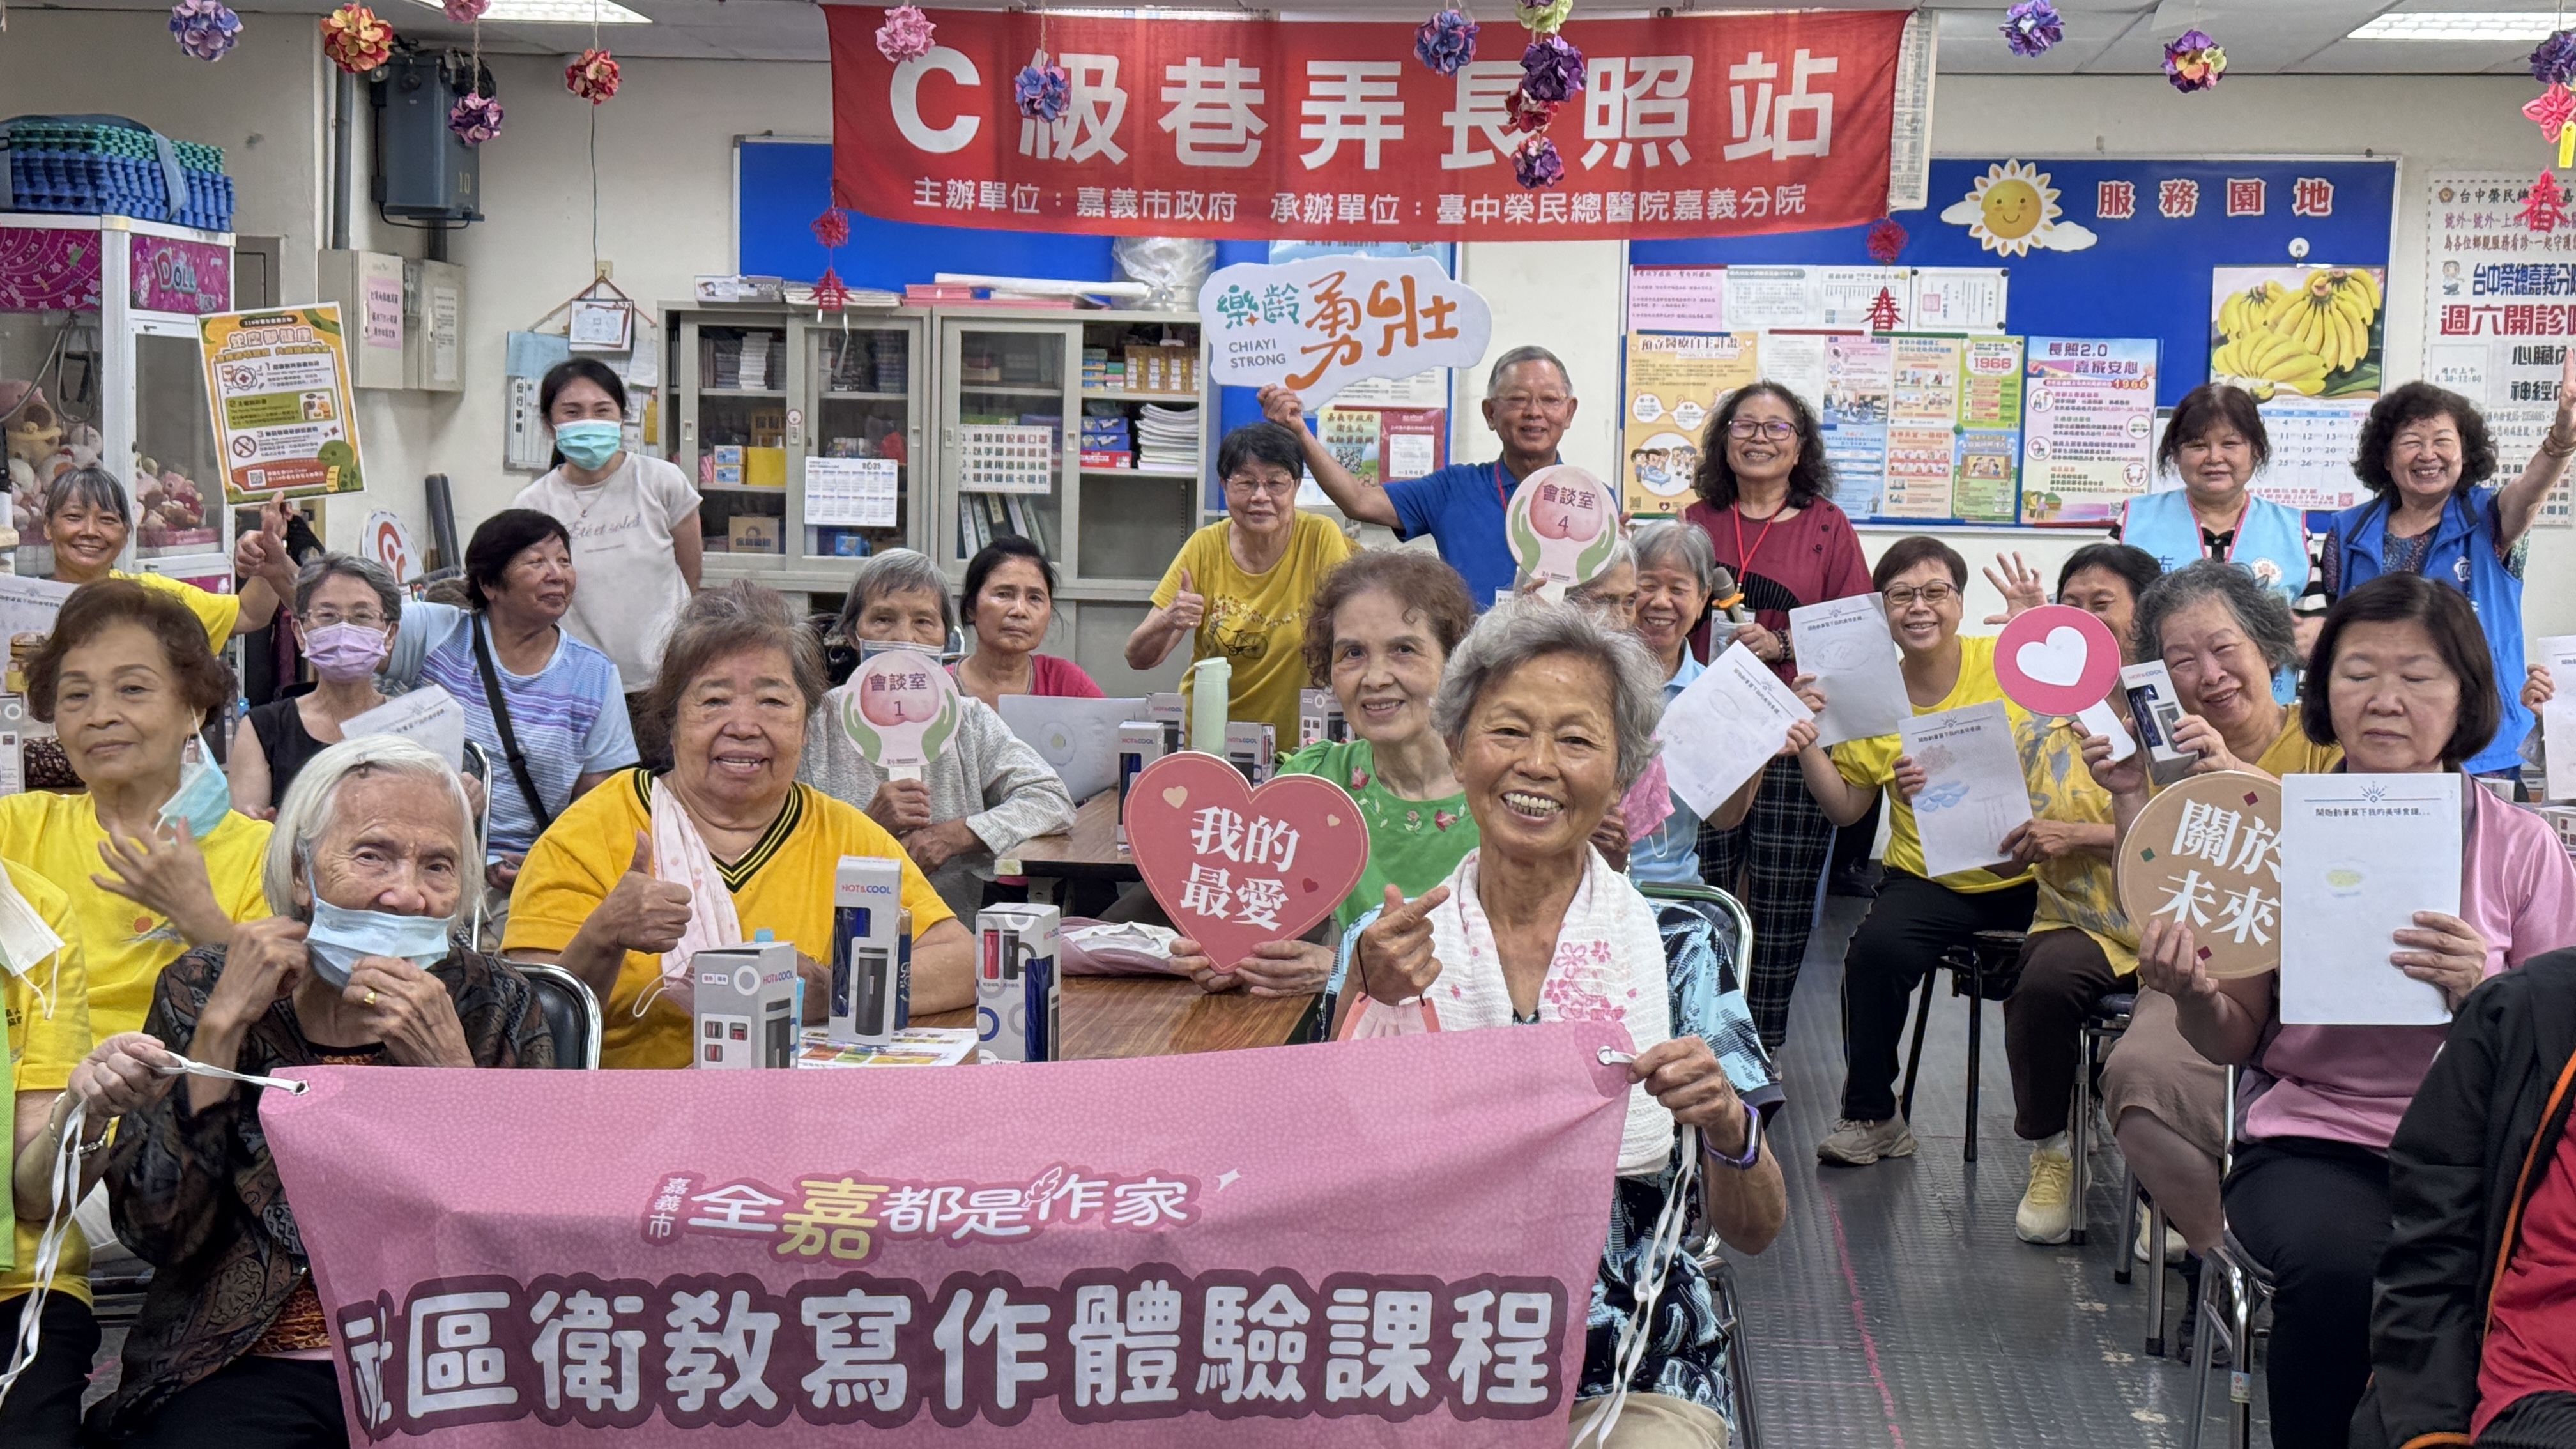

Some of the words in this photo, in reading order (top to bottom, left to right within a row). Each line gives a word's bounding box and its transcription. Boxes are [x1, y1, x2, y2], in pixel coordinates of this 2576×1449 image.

[890, 45, 1838, 169] C級巷弄長照站
[914, 177, 1237, 222] 主辦單位：嘉義市政府
[2097, 178, 2334, 218] 服務園地
[155, 247, 198, 293] DOLL
[1216, 282, 1301, 330] 樂齡
[1284, 270, 1459, 391] 勇壯
[1229, 338, 1276, 353] CHIAYI
[2049, 342, 2108, 357] 長照2.0
[1230, 353, 1286, 369] STRONG
[1974, 358, 2012, 369] 1966
[2115, 378, 2147, 389] 1966
[516, 375, 524, 433] 份行事曆
[1543, 484, 1595, 510] 會談室
[1558, 516, 1568, 532] 4
[869, 672, 927, 691] 會談室
[2128, 670, 2163, 680] HOT&COOL
[894, 700, 905, 716] 1
[1191, 806, 1300, 873] 我的
[2170, 798, 2281, 882] 關於
[842, 884, 892, 894] HOT&COOL
[1180, 862, 1289, 931] 最愛
[2150, 869, 2281, 947] 未來
[763, 970, 793, 984] HOT&COOL
[648, 1177, 692, 1239] 嘉義市
[687, 1172, 1190, 1261] 全嘉都是作家
